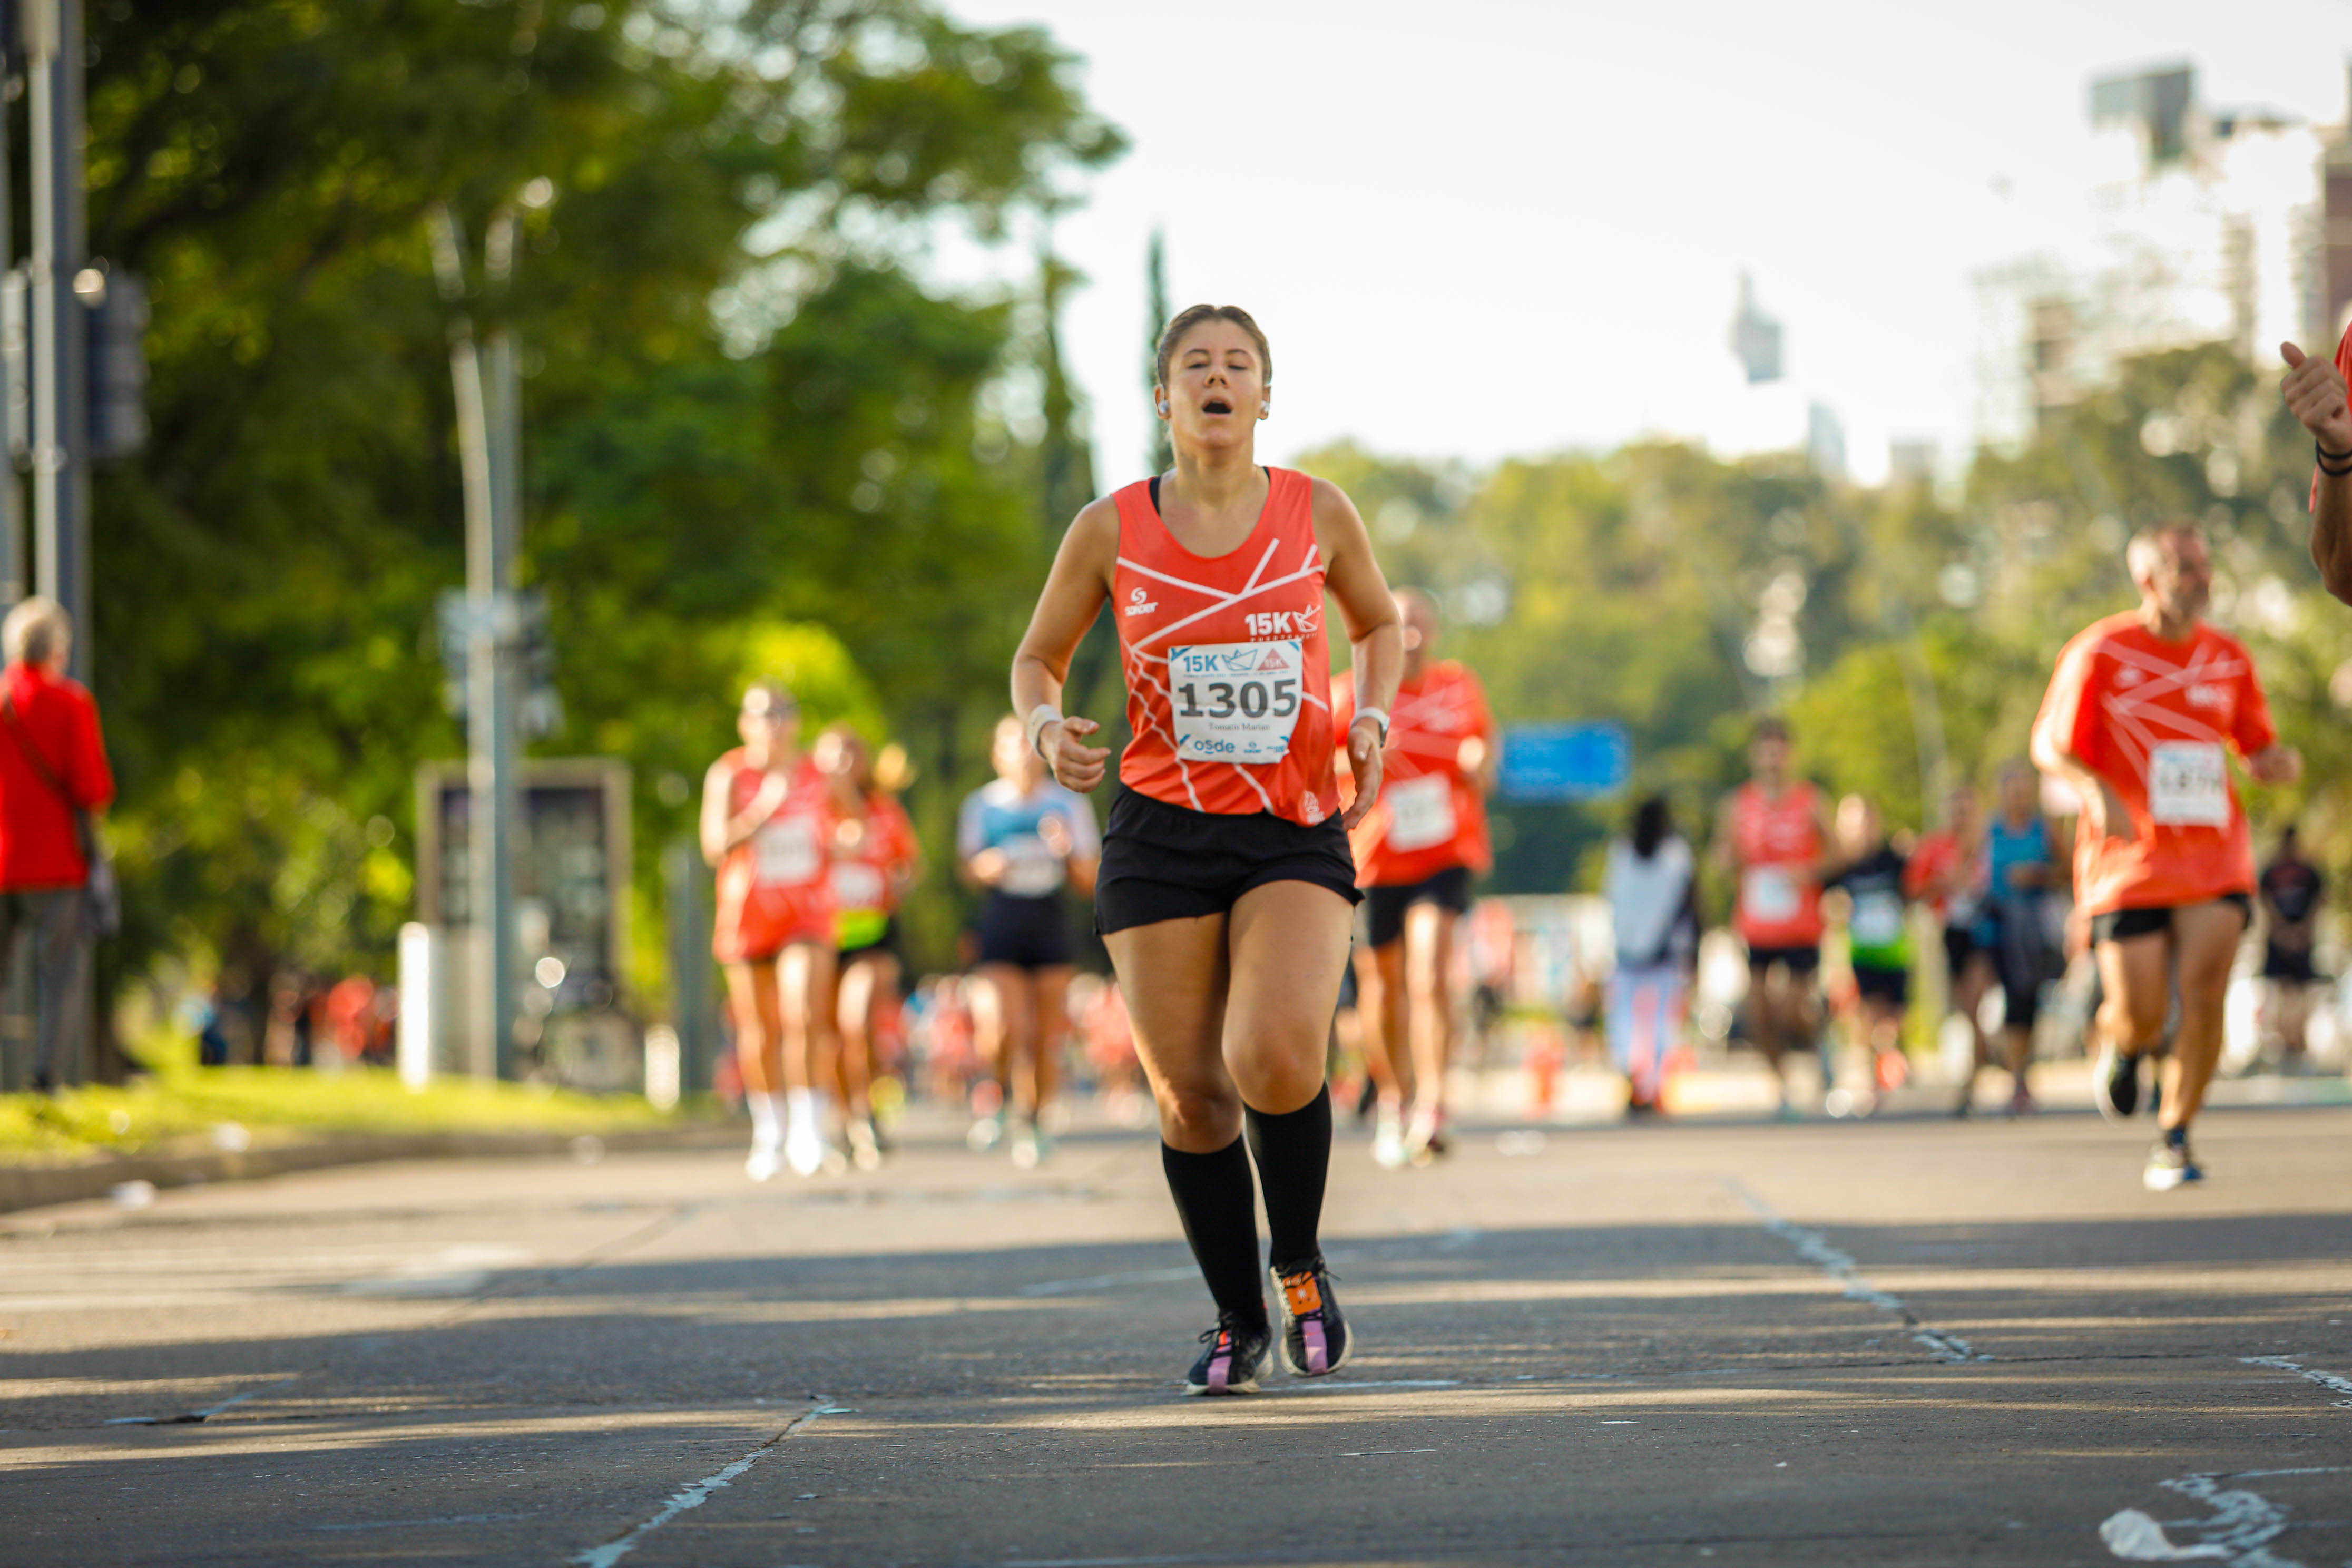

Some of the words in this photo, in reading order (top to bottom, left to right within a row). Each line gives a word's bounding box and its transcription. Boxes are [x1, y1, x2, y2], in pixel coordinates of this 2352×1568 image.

[1245, 611, 1292, 636] 15K
[1183, 654, 1219, 672] 15K
[1178, 679, 1296, 718] 1305
[1194, 739, 1236, 754] osde
